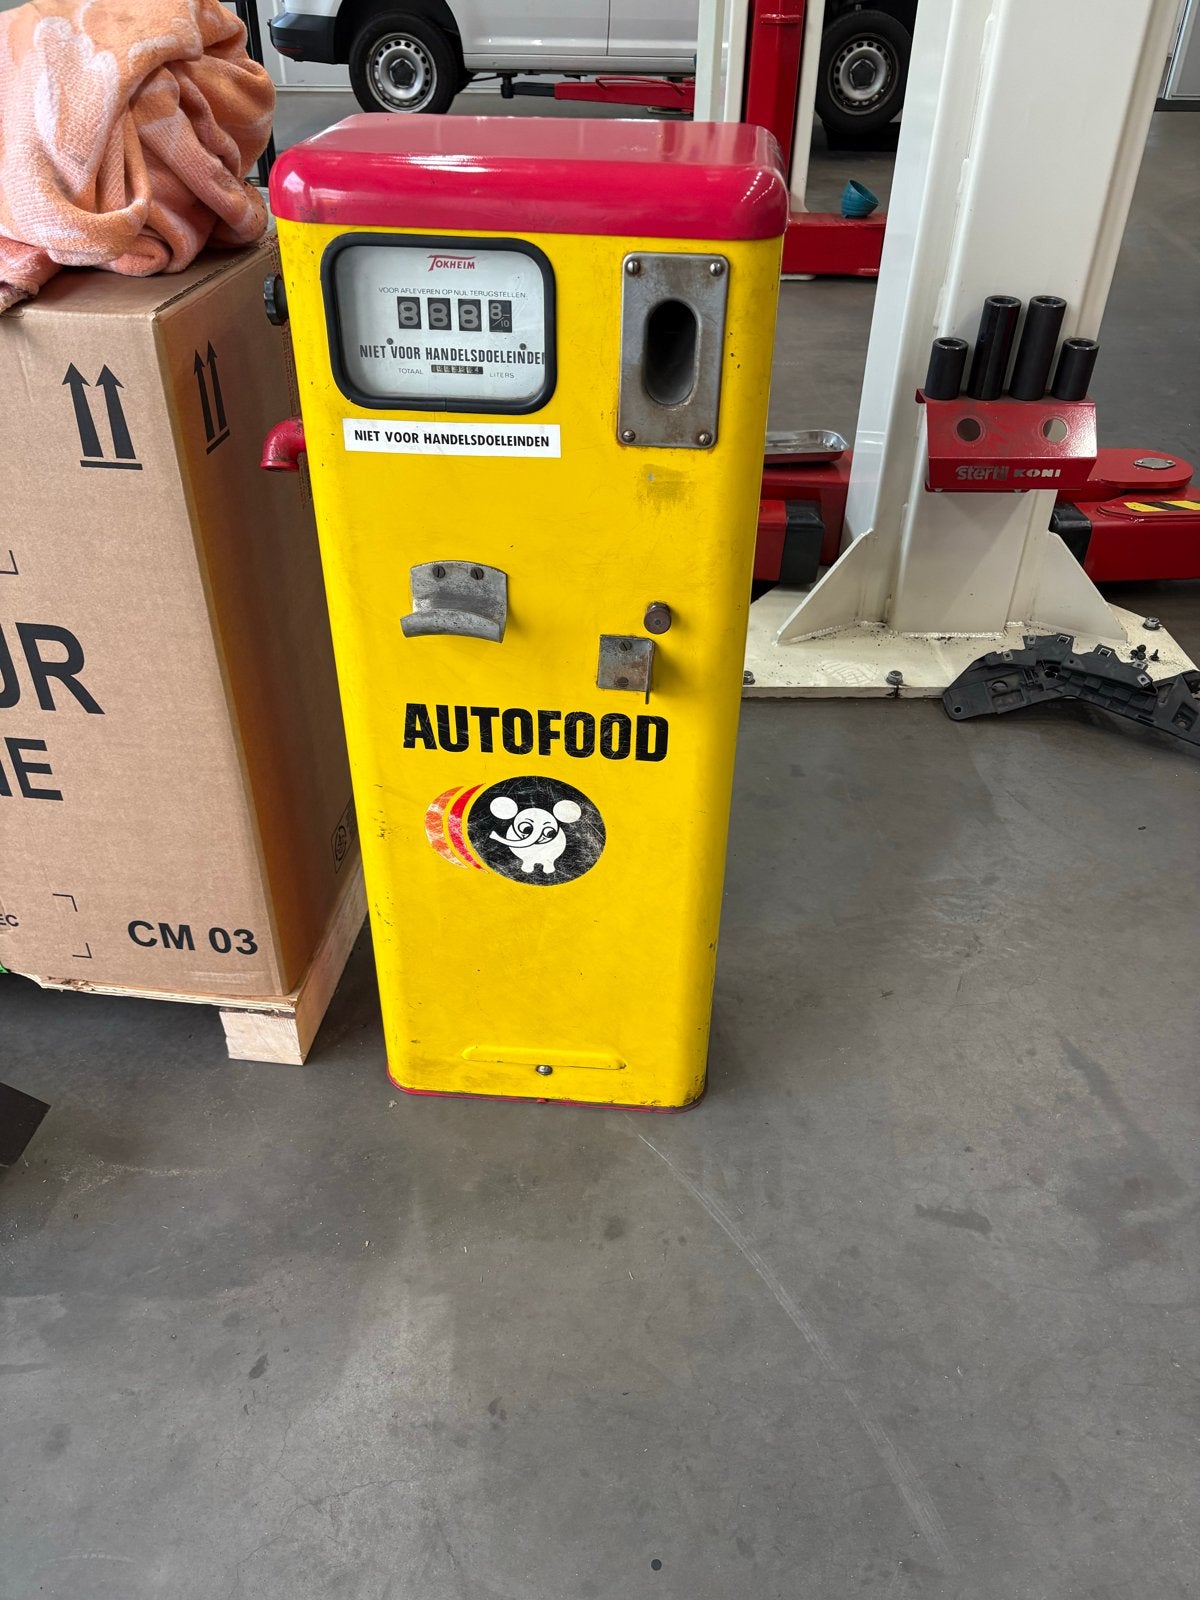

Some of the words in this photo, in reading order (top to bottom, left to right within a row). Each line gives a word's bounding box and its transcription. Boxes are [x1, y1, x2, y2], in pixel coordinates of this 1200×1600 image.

[427, 255, 476, 272] TOKHEIM
[400, 288, 440, 296] AFLEVEREN
[359, 345, 386, 358] NIET
[390, 346, 421, 360] VOOR
[354, 430, 380, 442] NIET
[385, 431, 419, 443] VOOR
[424, 433, 550, 447] HANDELSDOELEINDEN
[1013, 468, 1062, 478] KONI
[403, 703, 669, 762] AUTOFOOD
[0, 736, 64, 801] E
[127, 920, 196, 951] CM
[208, 927, 259, 955] 03
